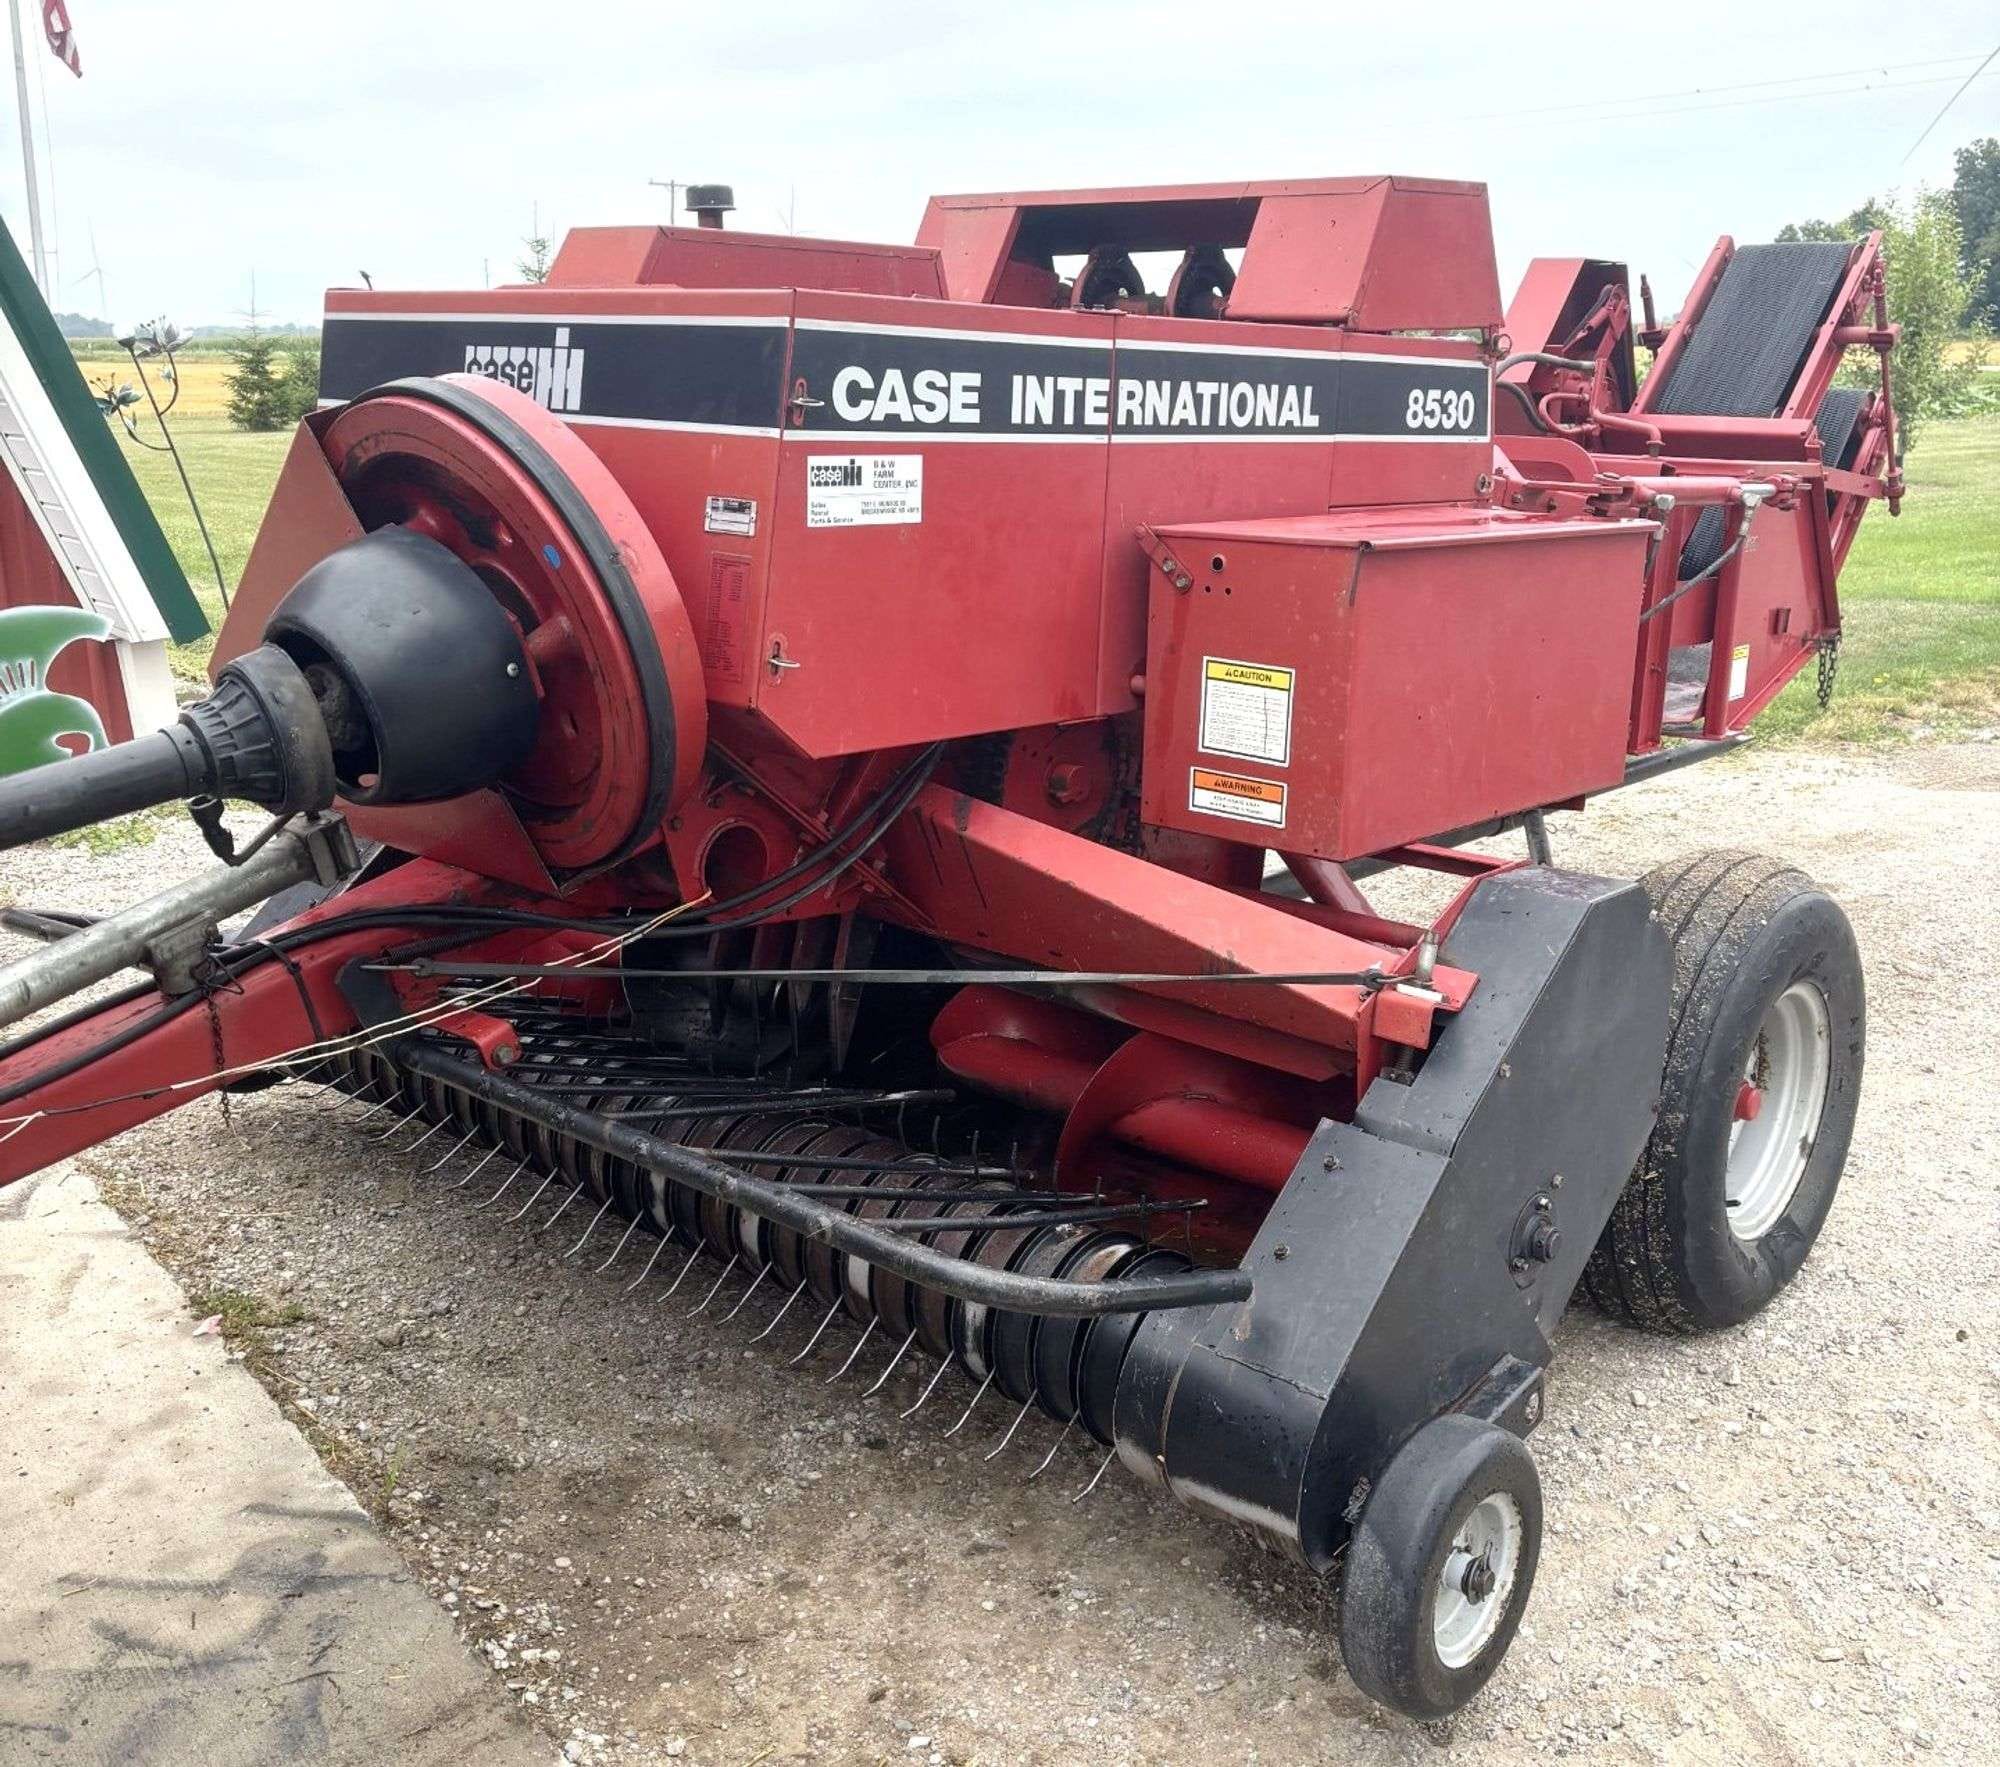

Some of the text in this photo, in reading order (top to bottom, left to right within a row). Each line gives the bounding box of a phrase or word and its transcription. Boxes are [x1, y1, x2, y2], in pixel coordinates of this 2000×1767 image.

[832, 365, 1475, 430] CASE INTERNATIONAL 8530
[873, 470, 895, 478] FARM
[1232, 669, 1273, 683] CAUTION
[1220, 778, 1263, 795] WARNING
